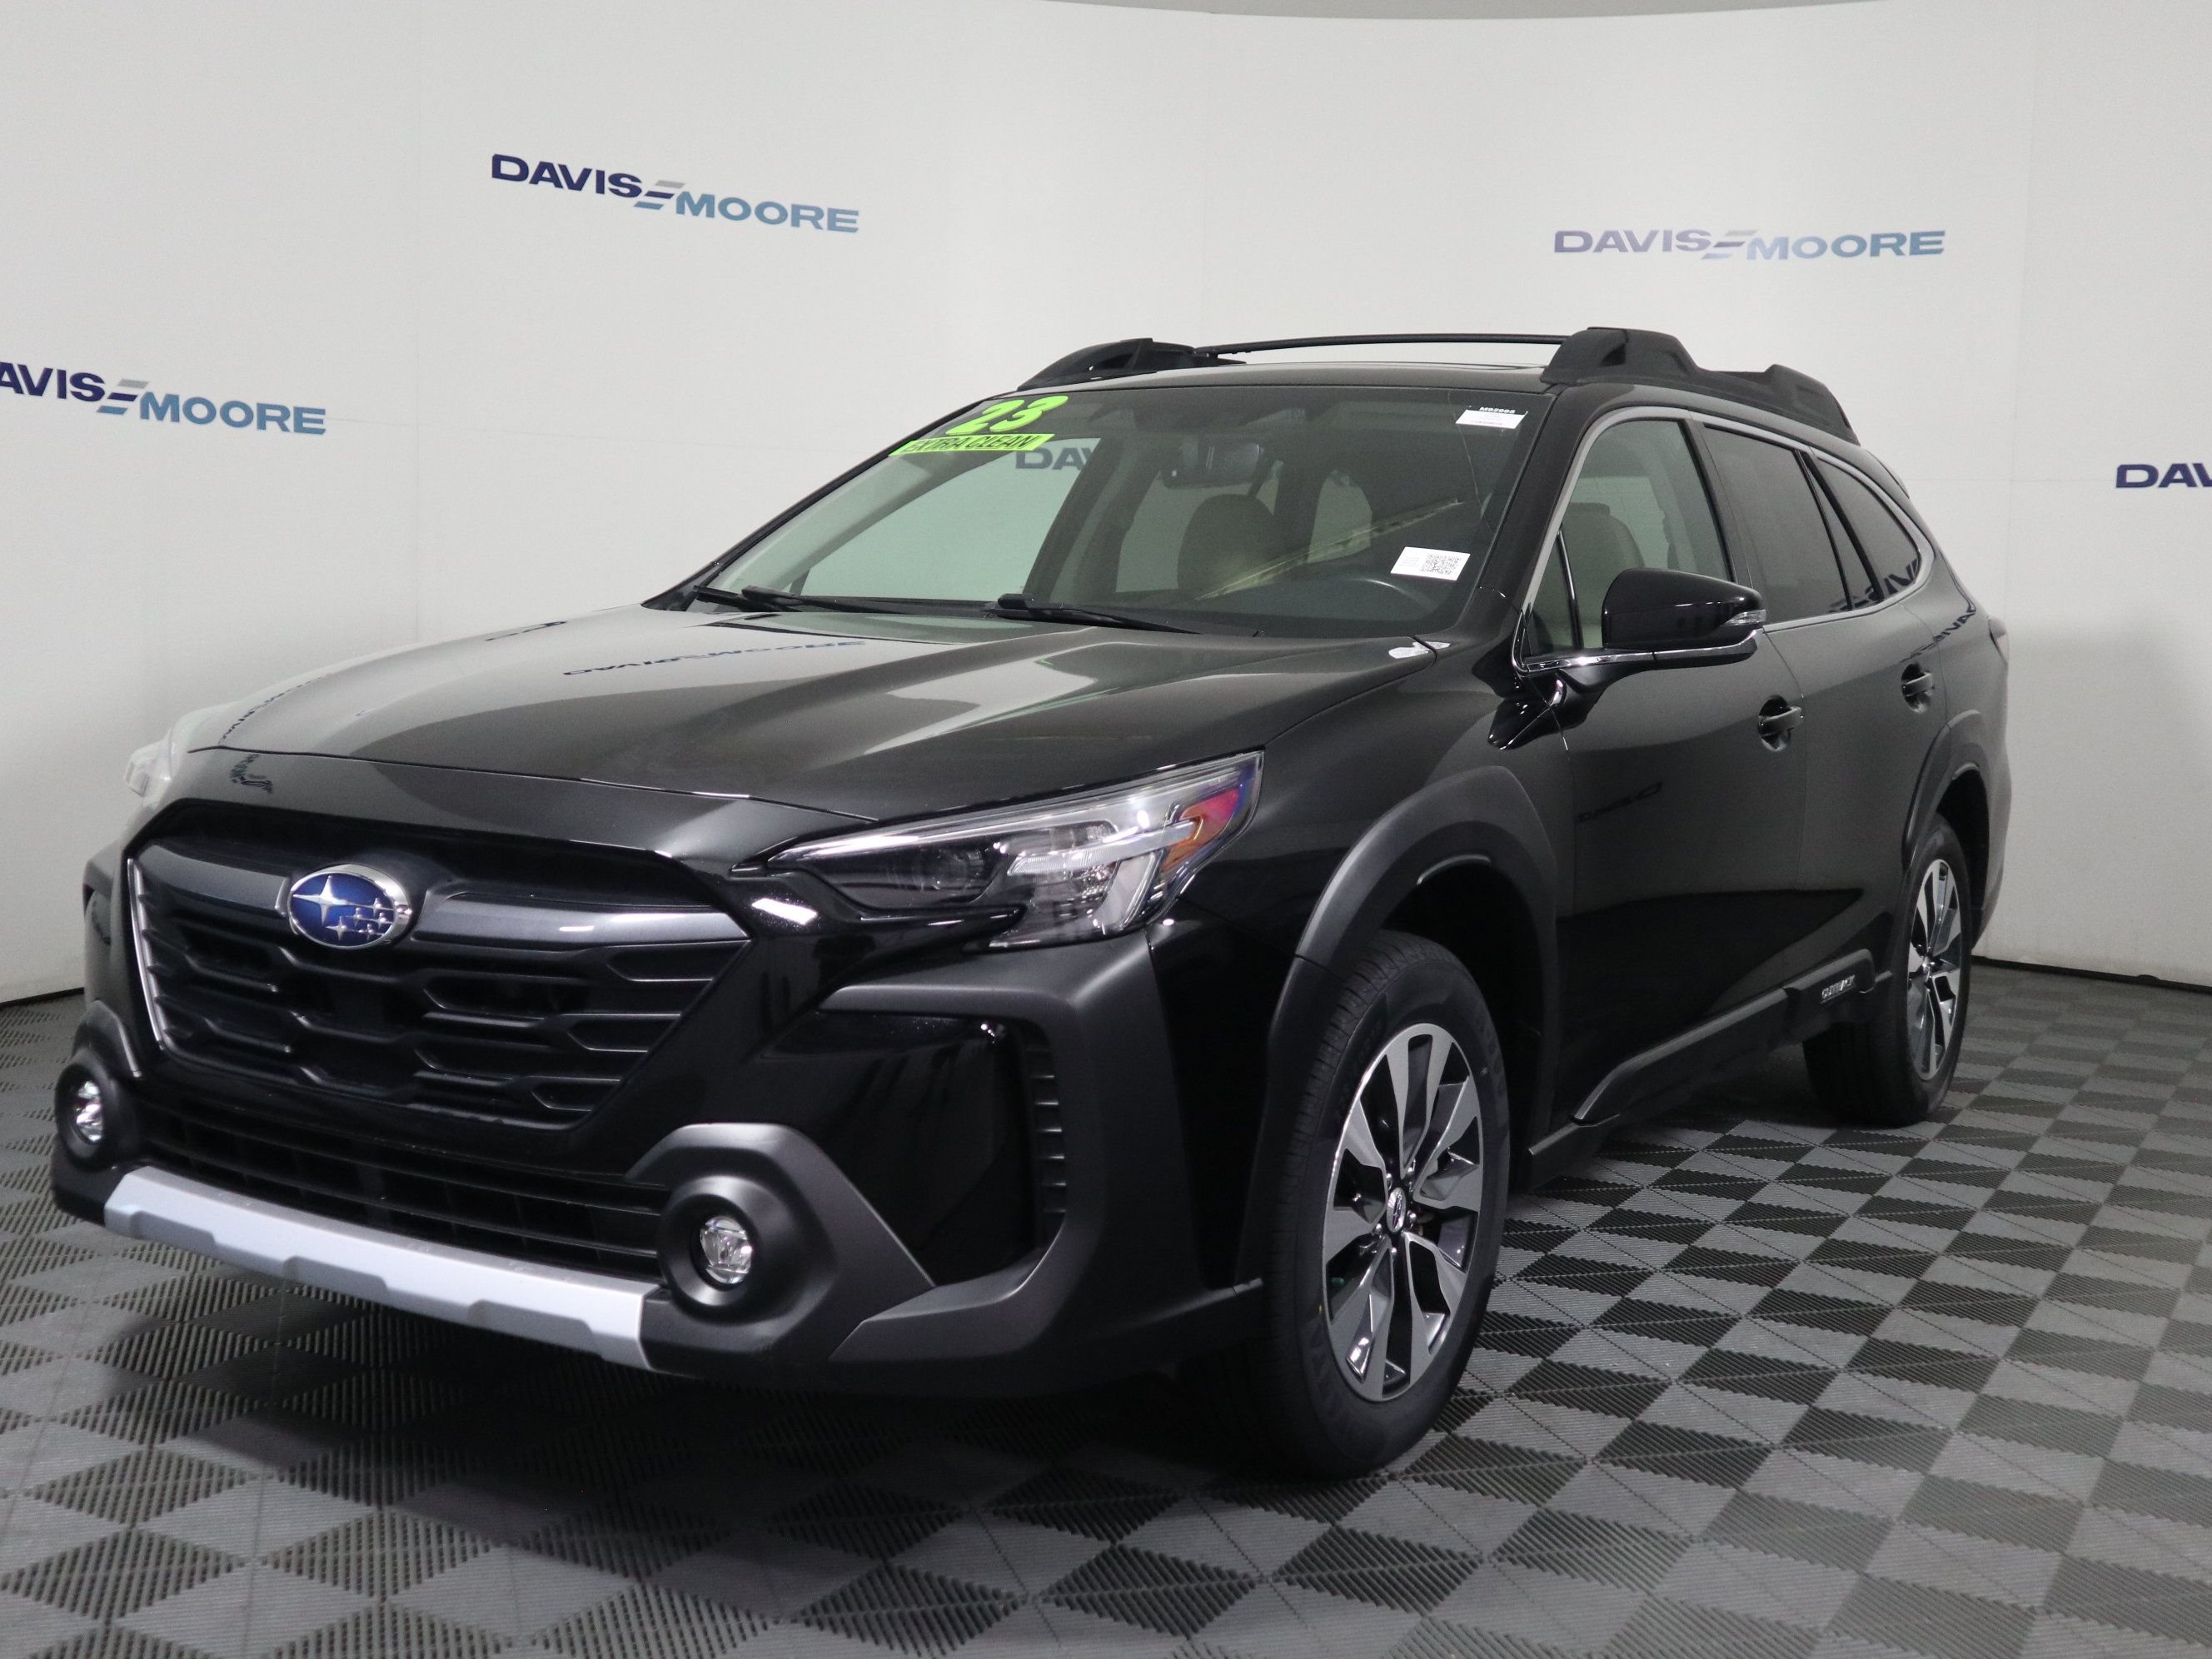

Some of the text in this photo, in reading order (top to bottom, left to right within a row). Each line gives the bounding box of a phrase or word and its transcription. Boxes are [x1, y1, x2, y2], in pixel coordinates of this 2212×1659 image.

[491, 153, 859, 233] DAVIS MOORE
[1554, 229, 1946, 261] DAVIS MOORE
[139, 391, 326, 435] MOORE
[945, 395, 1069, 435] 23
[964, 434, 1042, 449] CLEAN
[1015, 446, 1092, 470] DA
